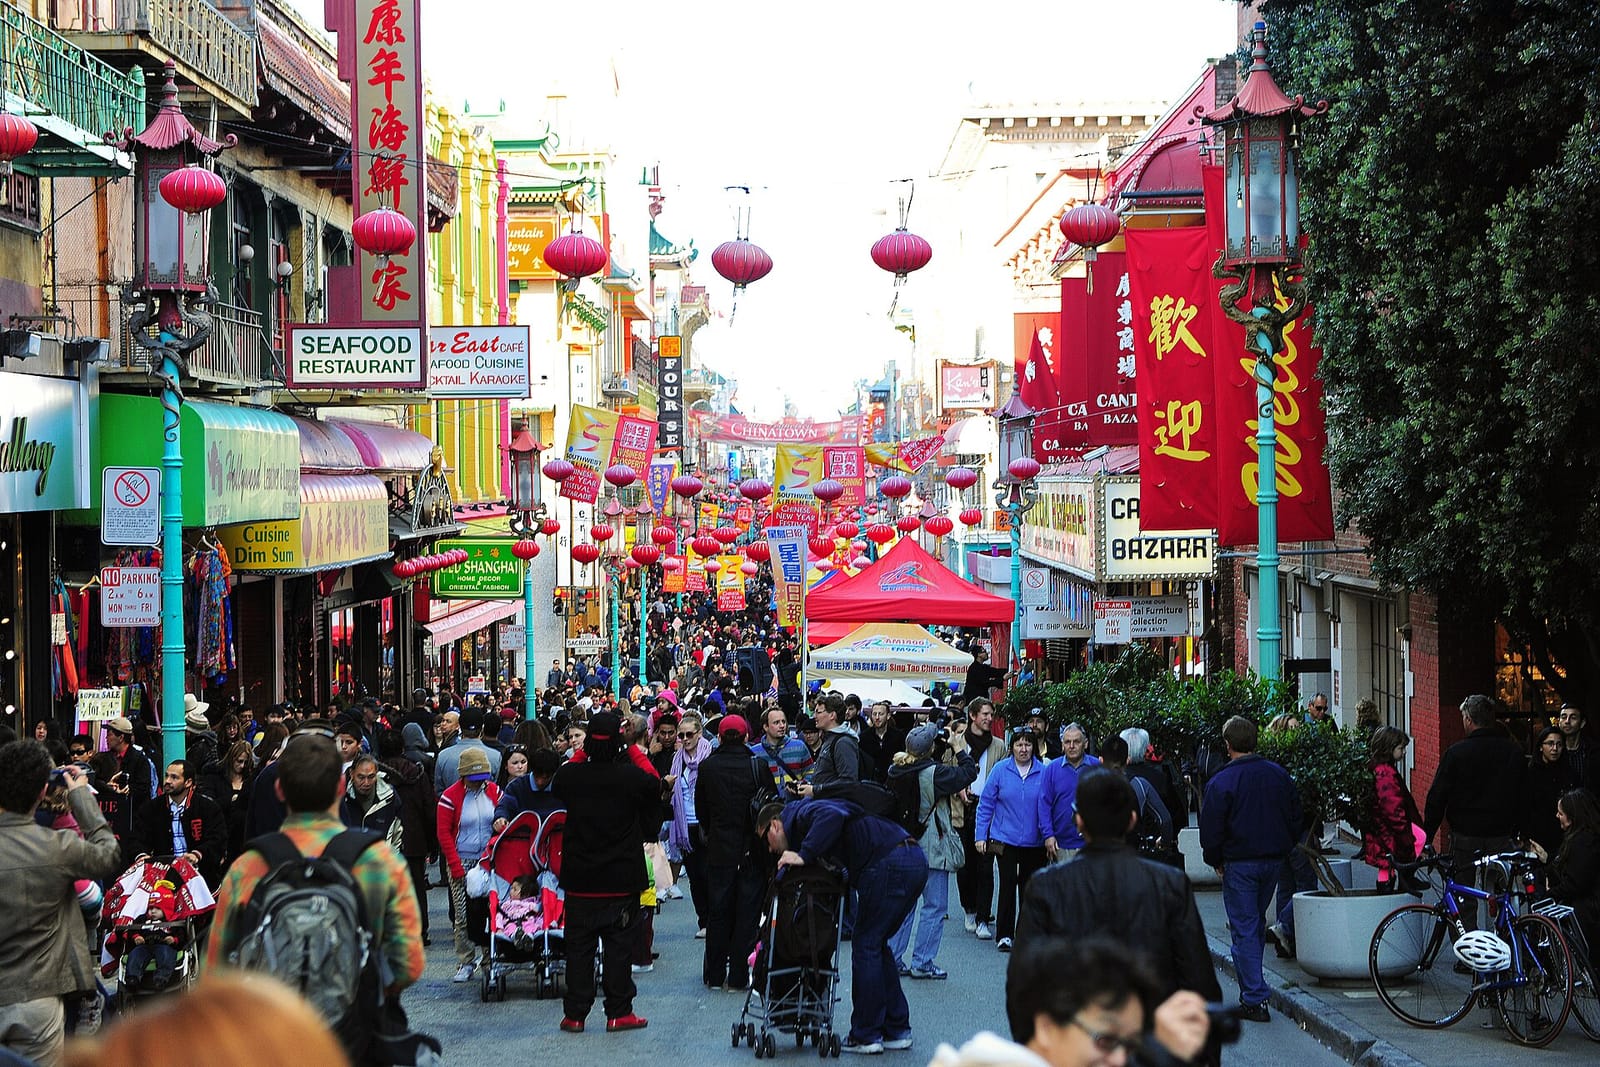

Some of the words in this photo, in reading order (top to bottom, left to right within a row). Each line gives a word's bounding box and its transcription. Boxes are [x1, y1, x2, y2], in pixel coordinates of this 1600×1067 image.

[363, 0, 411, 311] 康年海鮮家
[301, 335, 412, 354] SEAFOOD
[450, 332, 500, 353] East
[500, 341, 524, 353] CAFÉ
[299, 359, 416, 374] RESTAURANT
[1149, 294, 1211, 462] 歡迎
[664, 359, 679, 412] FOUR
[731, 421, 818, 438] CHINATOWN
[566, 452, 603, 466] SOUTHWEST
[776, 499, 816, 507] AIRLINES
[777, 492, 816, 500] SOUTHWEST
[781, 504, 811, 514] CHINESE
[776, 511, 794, 521] NEW
[796, 513, 816, 522] YEAR
[243, 526, 290, 543] Cuisine
[235, 546, 266, 563] Dim
[272, 546, 294, 563] Sum
[1112, 538, 1208, 560] BAZAAR
[464, 560, 518, 574] SHANGHAI
[103, 570, 119, 585] NO
[121, 573, 158, 585] PARKING
[778, 543, 801, 624] 星島日報
[108, 587, 114, 600] 2
[137, 587, 143, 599] 6
[108, 603, 123, 613] MON
[141, 603, 152, 613] FRI
[1095, 610, 1105, 619] NO
[1106, 610, 1130, 618] STOPPING
[1145, 606, 1183, 615] Furniture
[889, 663, 906, 673] Sing
[907, 664, 920, 673] Tao
[921, 664, 951, 673] Chinese
[101, 690, 121, 699] SALE
